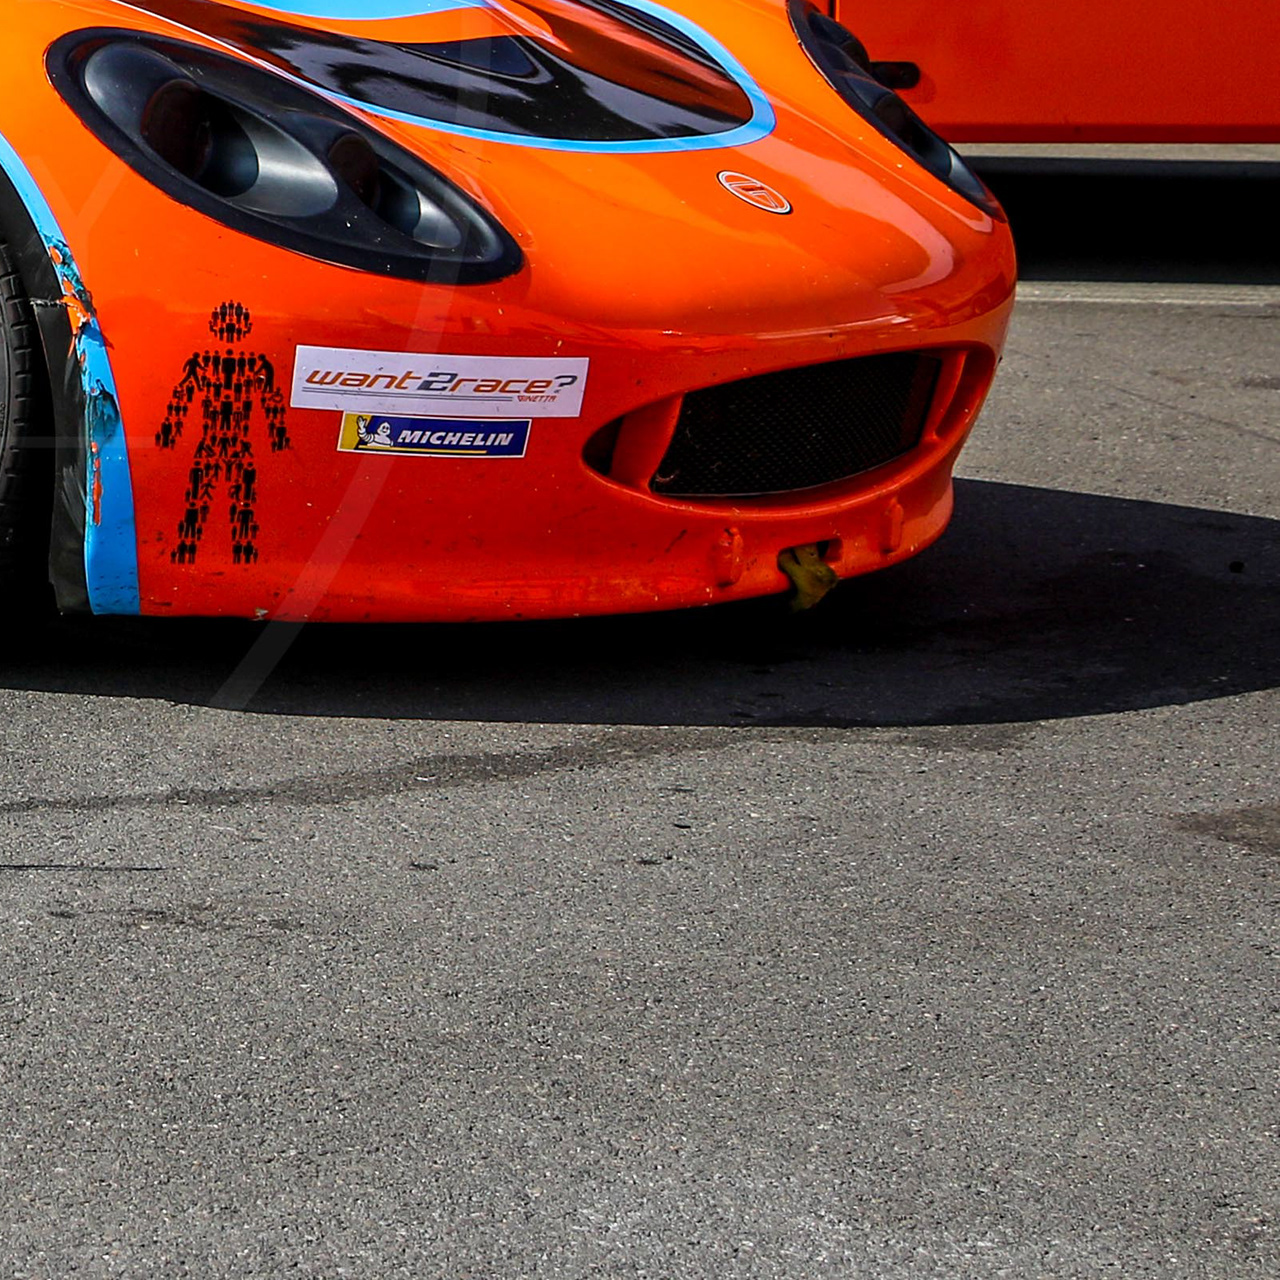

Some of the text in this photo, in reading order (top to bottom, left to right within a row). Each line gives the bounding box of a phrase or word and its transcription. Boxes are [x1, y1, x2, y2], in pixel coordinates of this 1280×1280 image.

[305, 369, 579, 395] want2race?
[517, 394, 558, 403] GINETTA
[397, 429, 515, 447] MICHELIN
